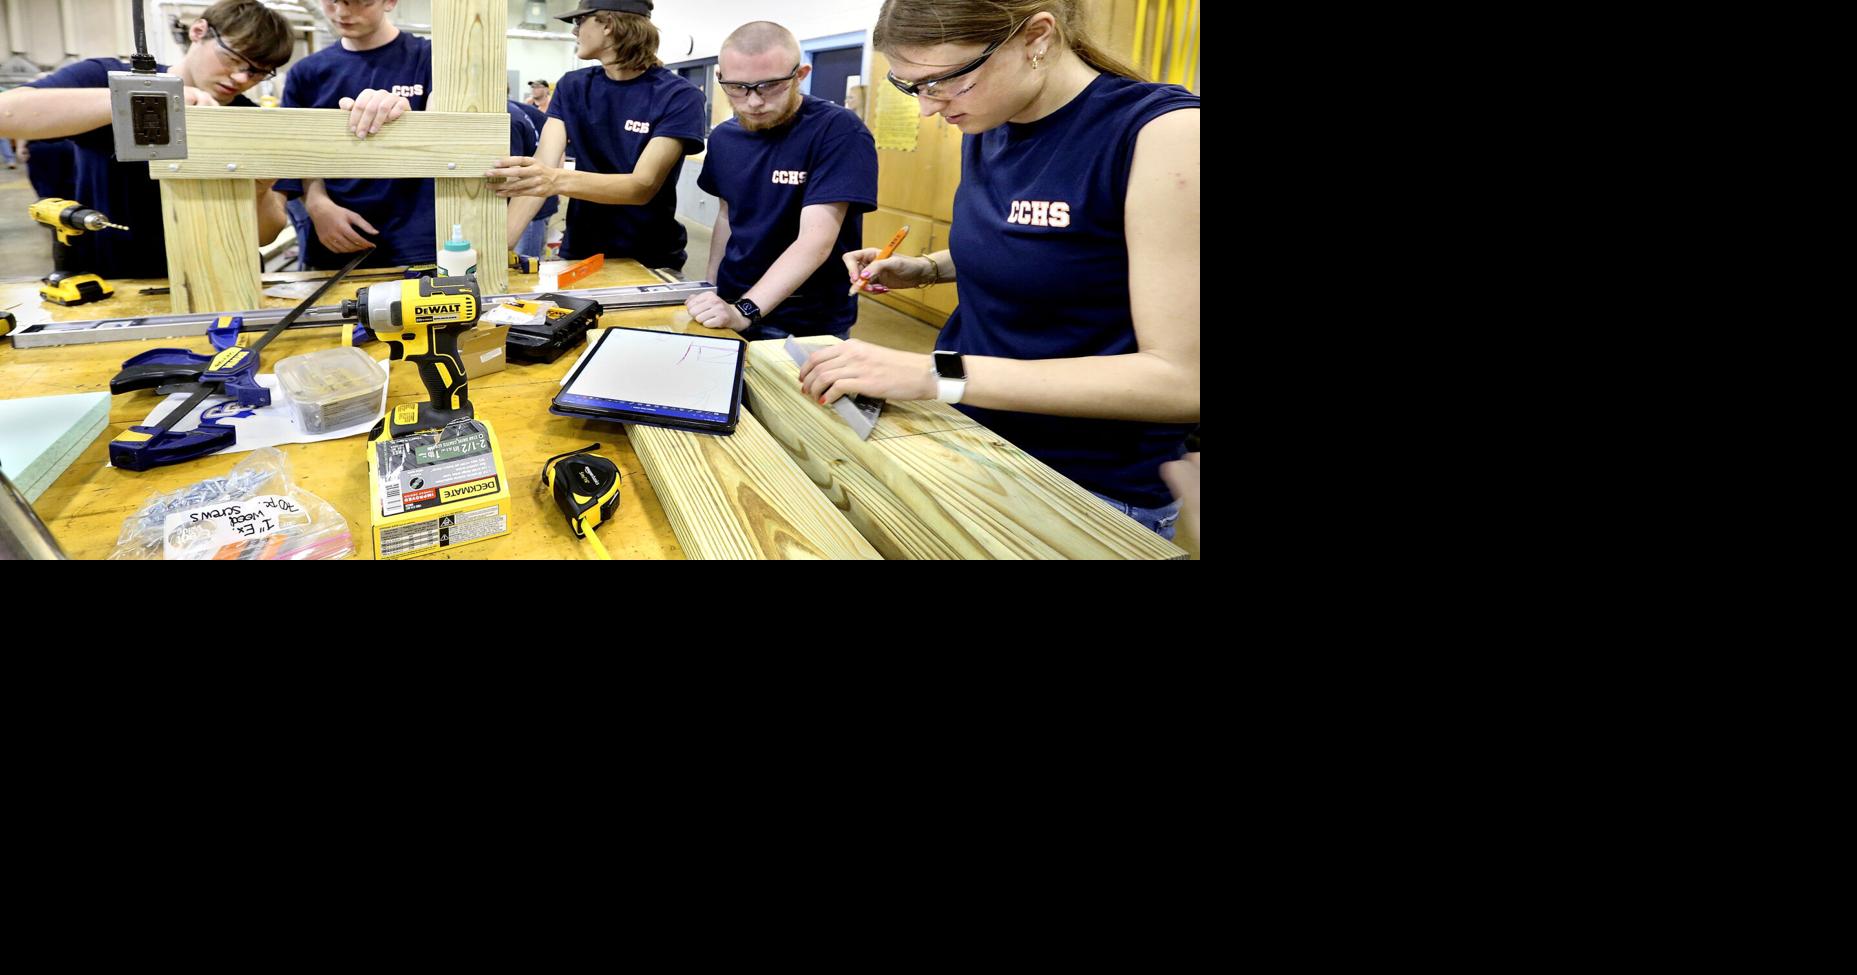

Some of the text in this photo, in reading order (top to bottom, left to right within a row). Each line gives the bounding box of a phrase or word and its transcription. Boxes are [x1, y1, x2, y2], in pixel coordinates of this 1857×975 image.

[1007, 200, 1071, 228] CCHS
[403, 492, 434, 502] IMPROVED
[444, 481, 495, 499] DECKMATE
[232, 523, 255, 537] Ex.
